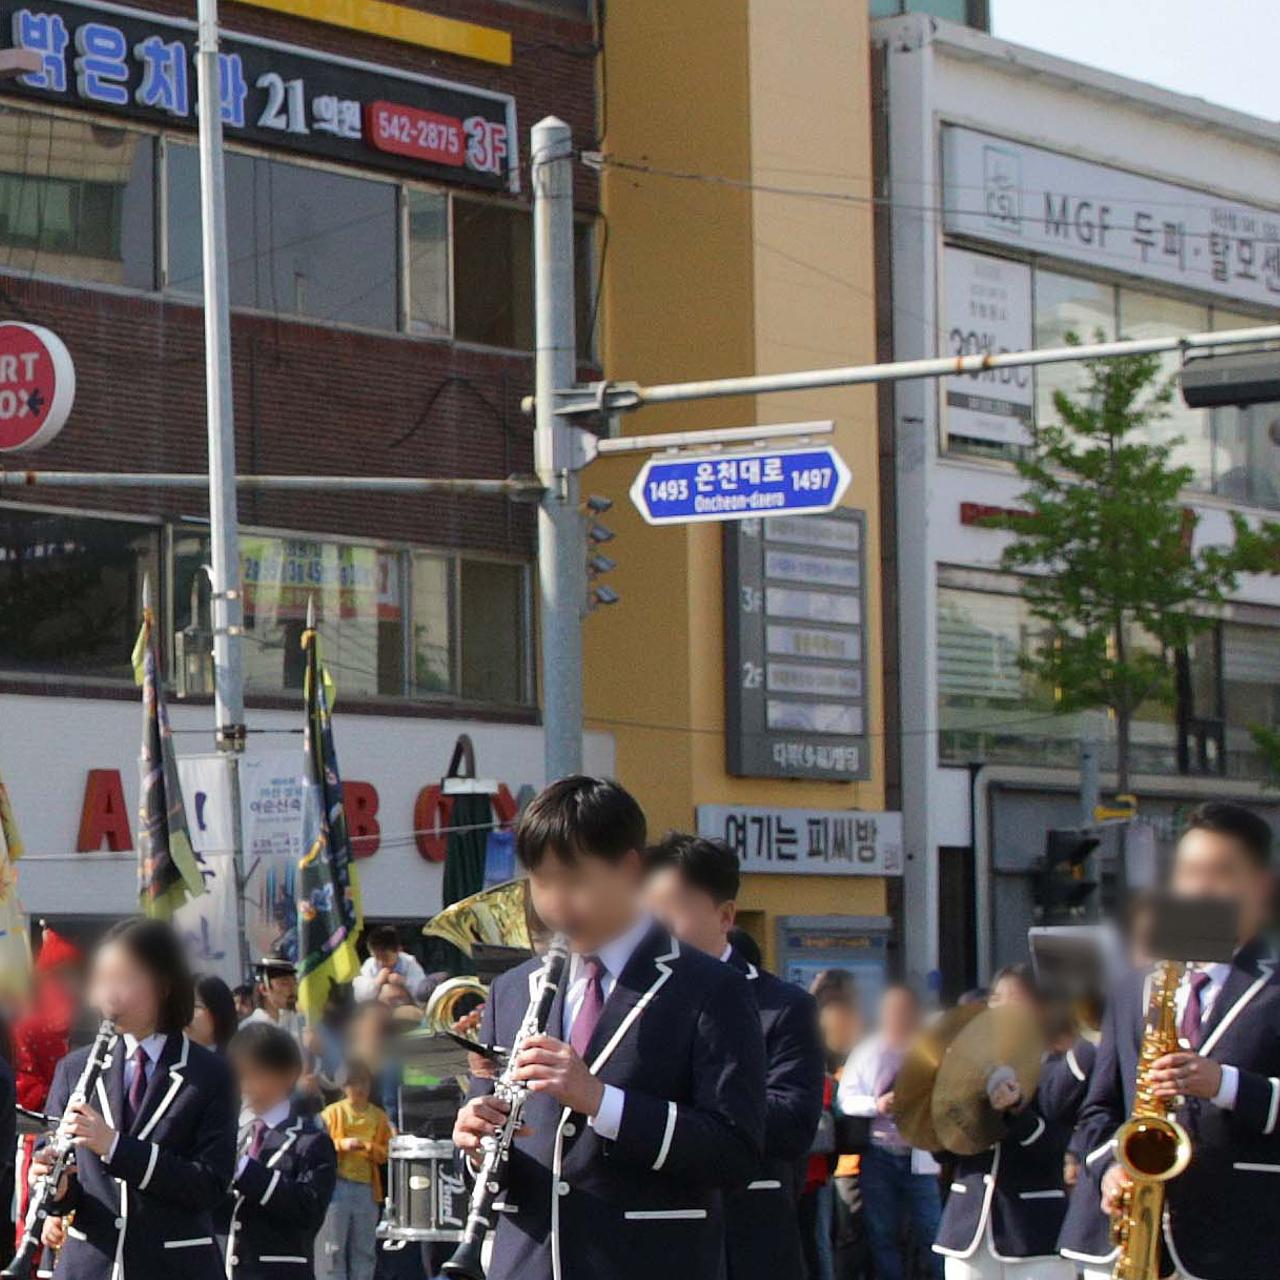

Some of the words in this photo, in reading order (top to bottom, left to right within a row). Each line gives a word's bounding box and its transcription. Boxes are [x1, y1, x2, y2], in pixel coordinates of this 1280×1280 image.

[255, 73, 310, 135] 21
[312, 95, 362, 139] 의원
[378, 111, 459, 154] 542-2875
[462, 116, 508, 175] 3F
[1043, 191, 1112, 248] MGF
[650, 479, 689, 502] 1493
[694, 457, 785, 492] 온천대로
[792, 468, 832, 491] 1497
[725, 814, 798, 861] 여기는
[807, 816, 877, 863] 피씨방
